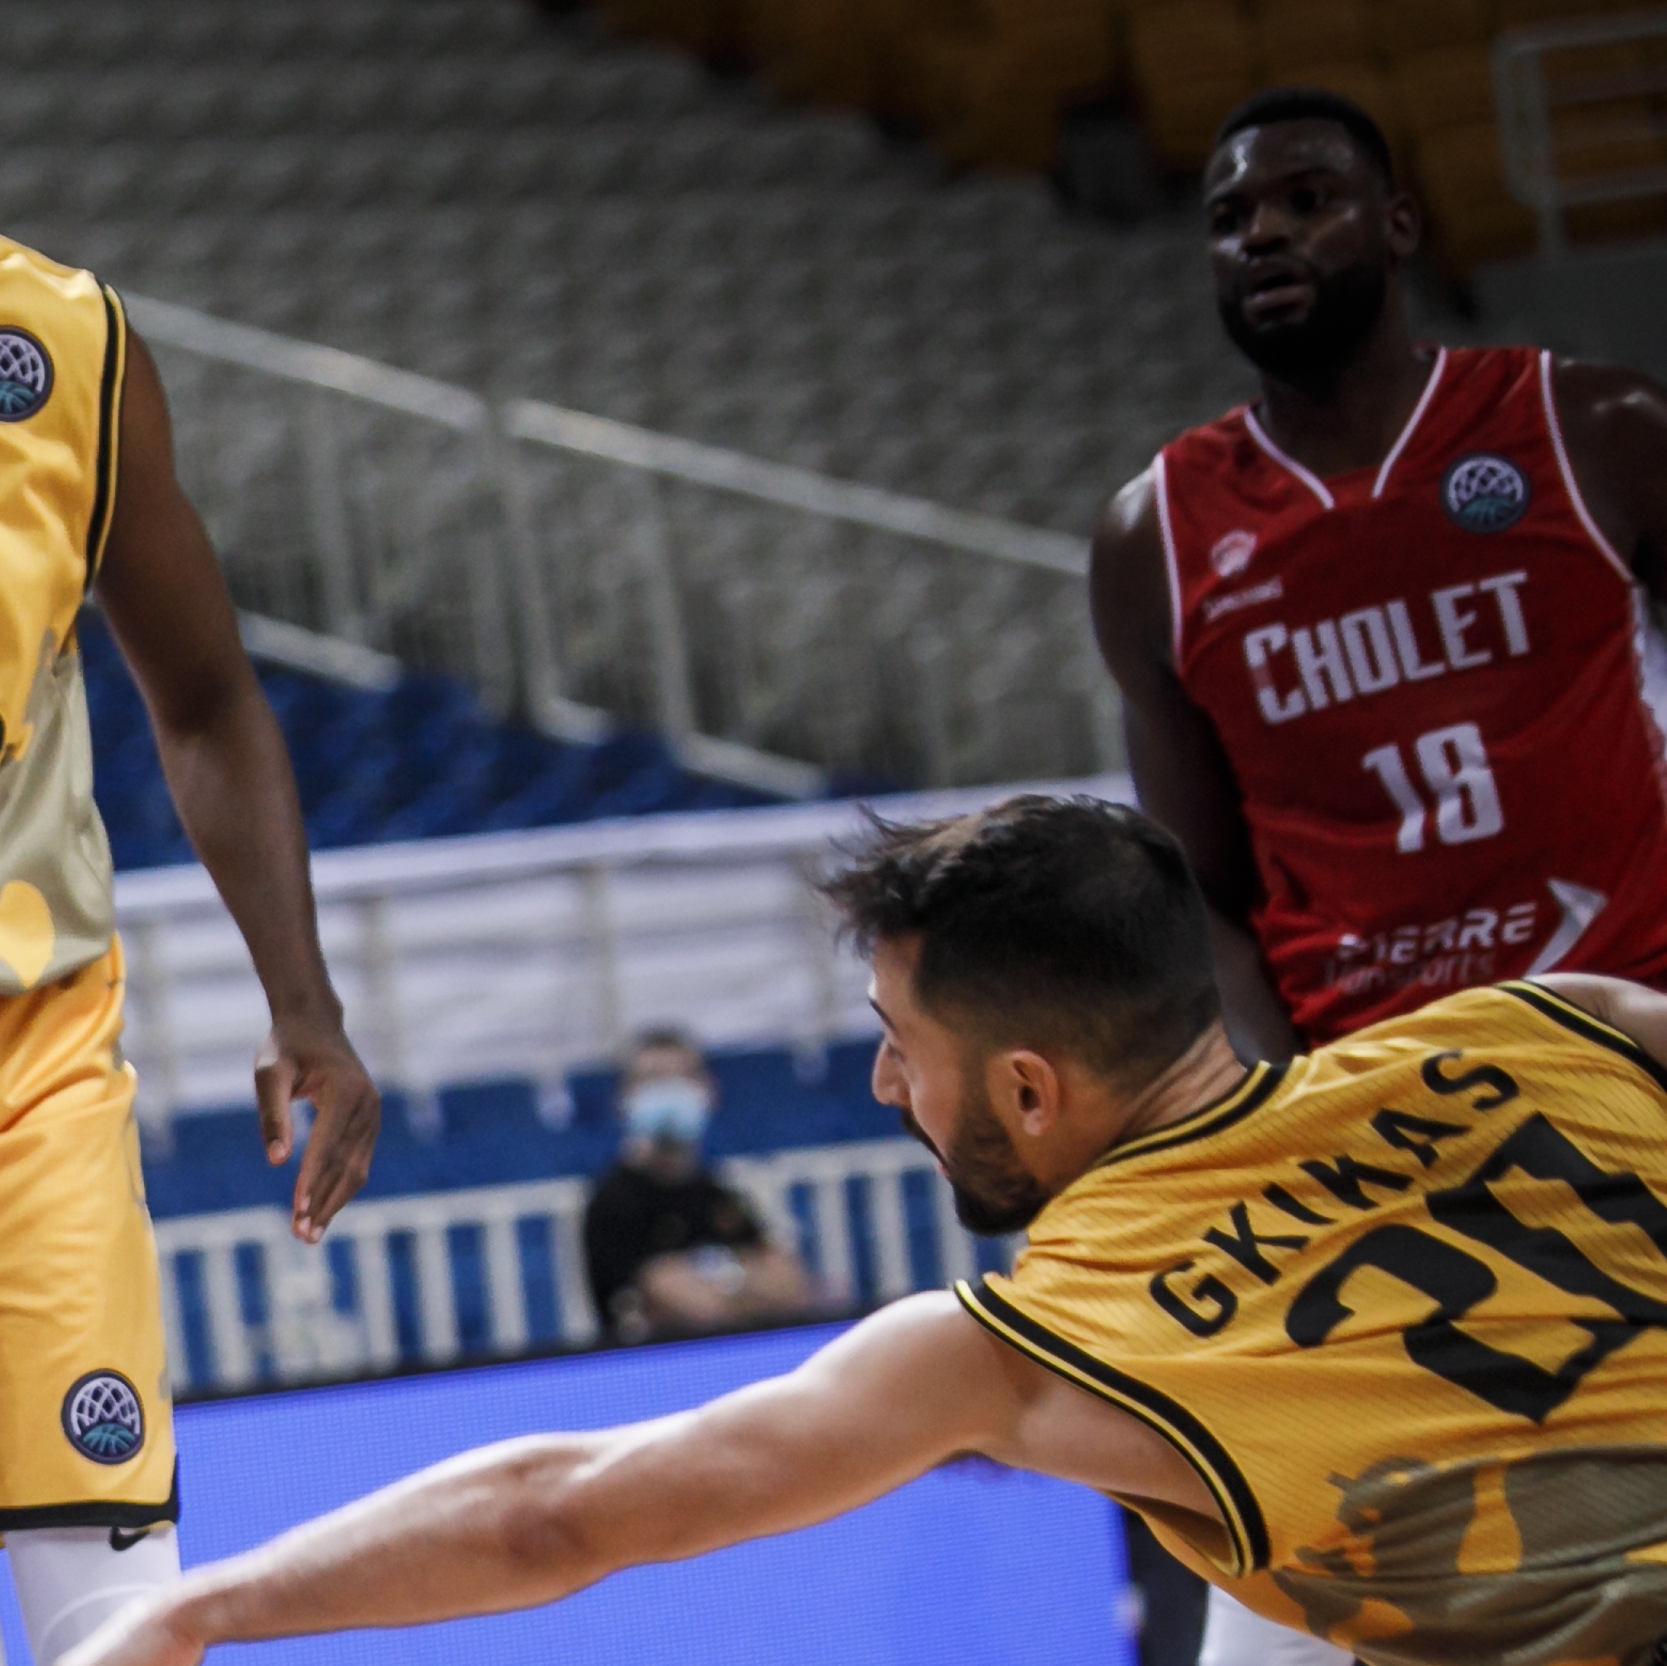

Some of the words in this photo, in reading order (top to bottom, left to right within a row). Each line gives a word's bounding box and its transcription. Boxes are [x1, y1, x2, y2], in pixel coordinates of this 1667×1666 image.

[1244, 569, 1530, 725] CHOLET
[1361, 722, 1505, 854] 18
[1147, 1049, 1521, 1339] GKIKAS
[1284, 1111, 1667, 1426] 20
